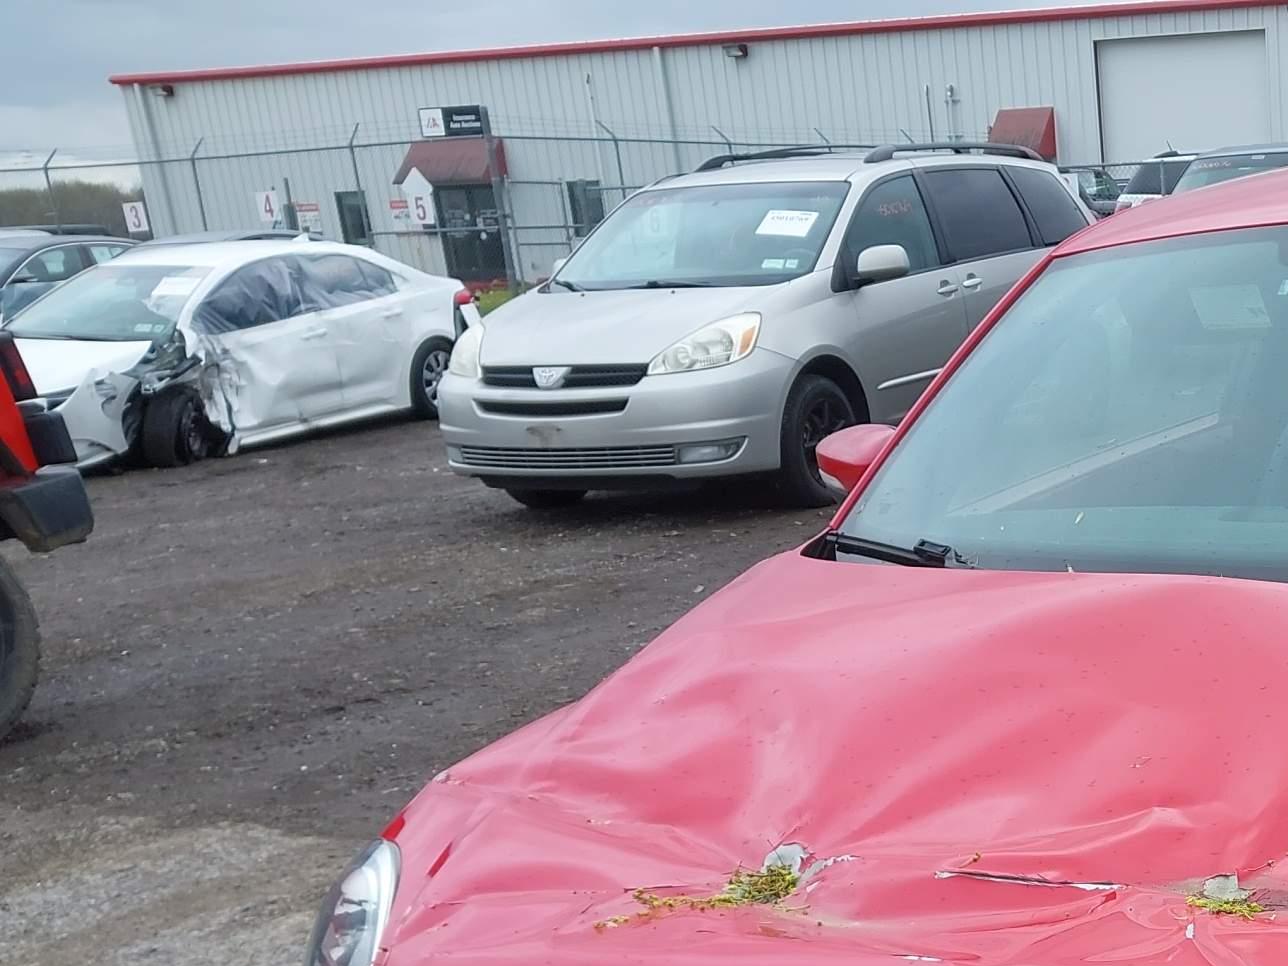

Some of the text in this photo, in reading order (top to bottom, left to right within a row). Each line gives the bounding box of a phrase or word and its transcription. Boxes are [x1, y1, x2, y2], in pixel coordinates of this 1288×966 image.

[129, 205, 142, 229] 3
[264, 194, 274, 218] 4
[414, 196, 427, 221] 5
